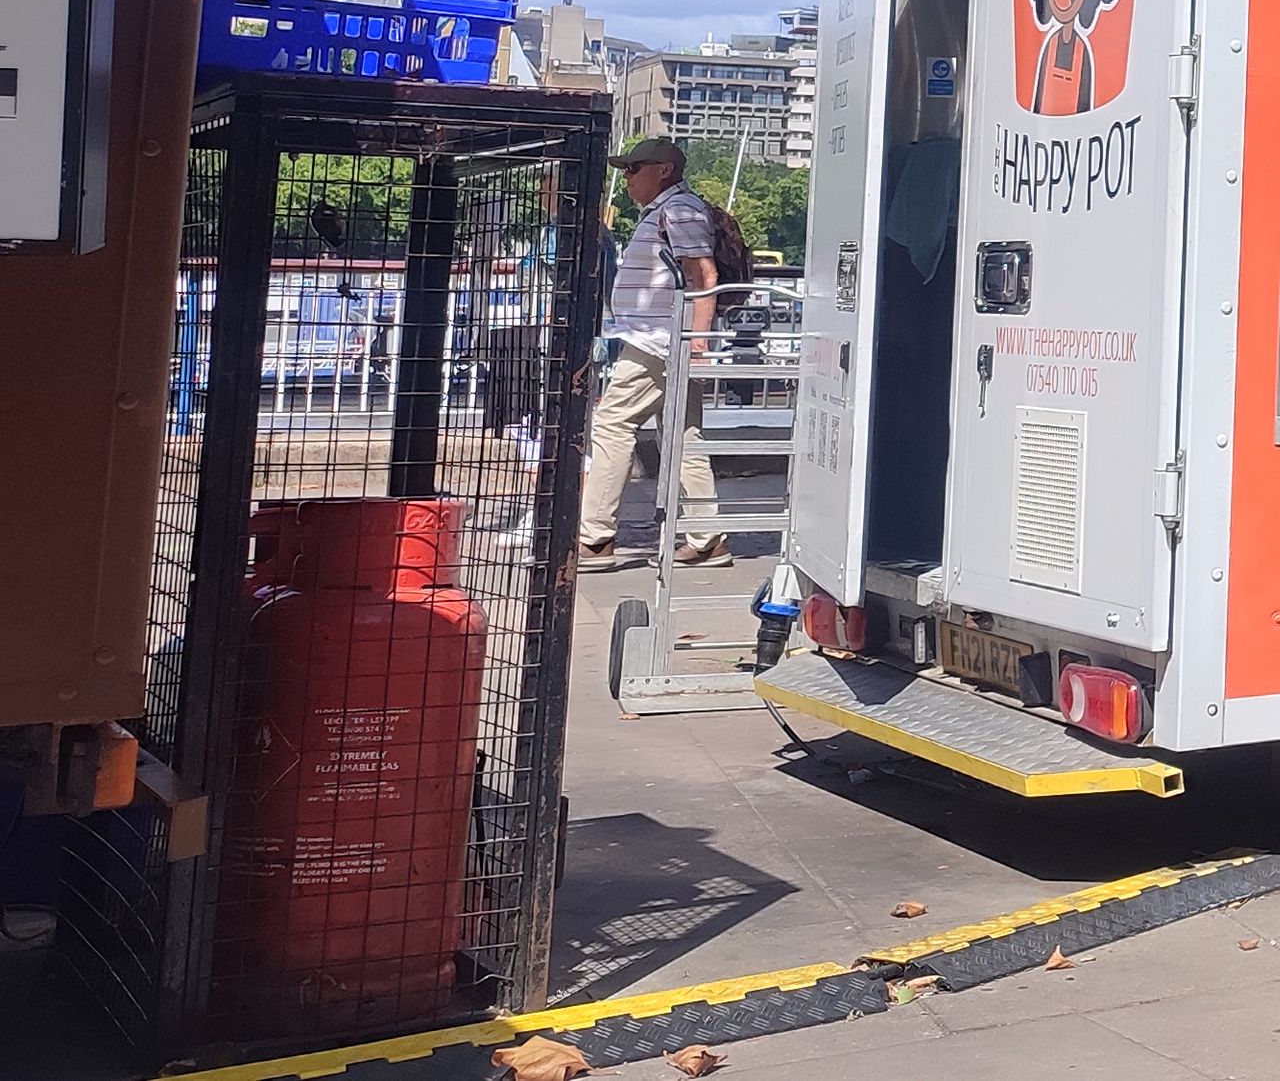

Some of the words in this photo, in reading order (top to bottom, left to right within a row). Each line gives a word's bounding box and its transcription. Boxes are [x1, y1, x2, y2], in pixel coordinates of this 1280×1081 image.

[1001, 129, 1082, 213] HAPPY
[1086, 115, 1142, 212] POT
[1026, 364, 1059, 394] 07540
[1062, 366, 1077, 395] 110
[1081, 367, 1098, 397] 015
